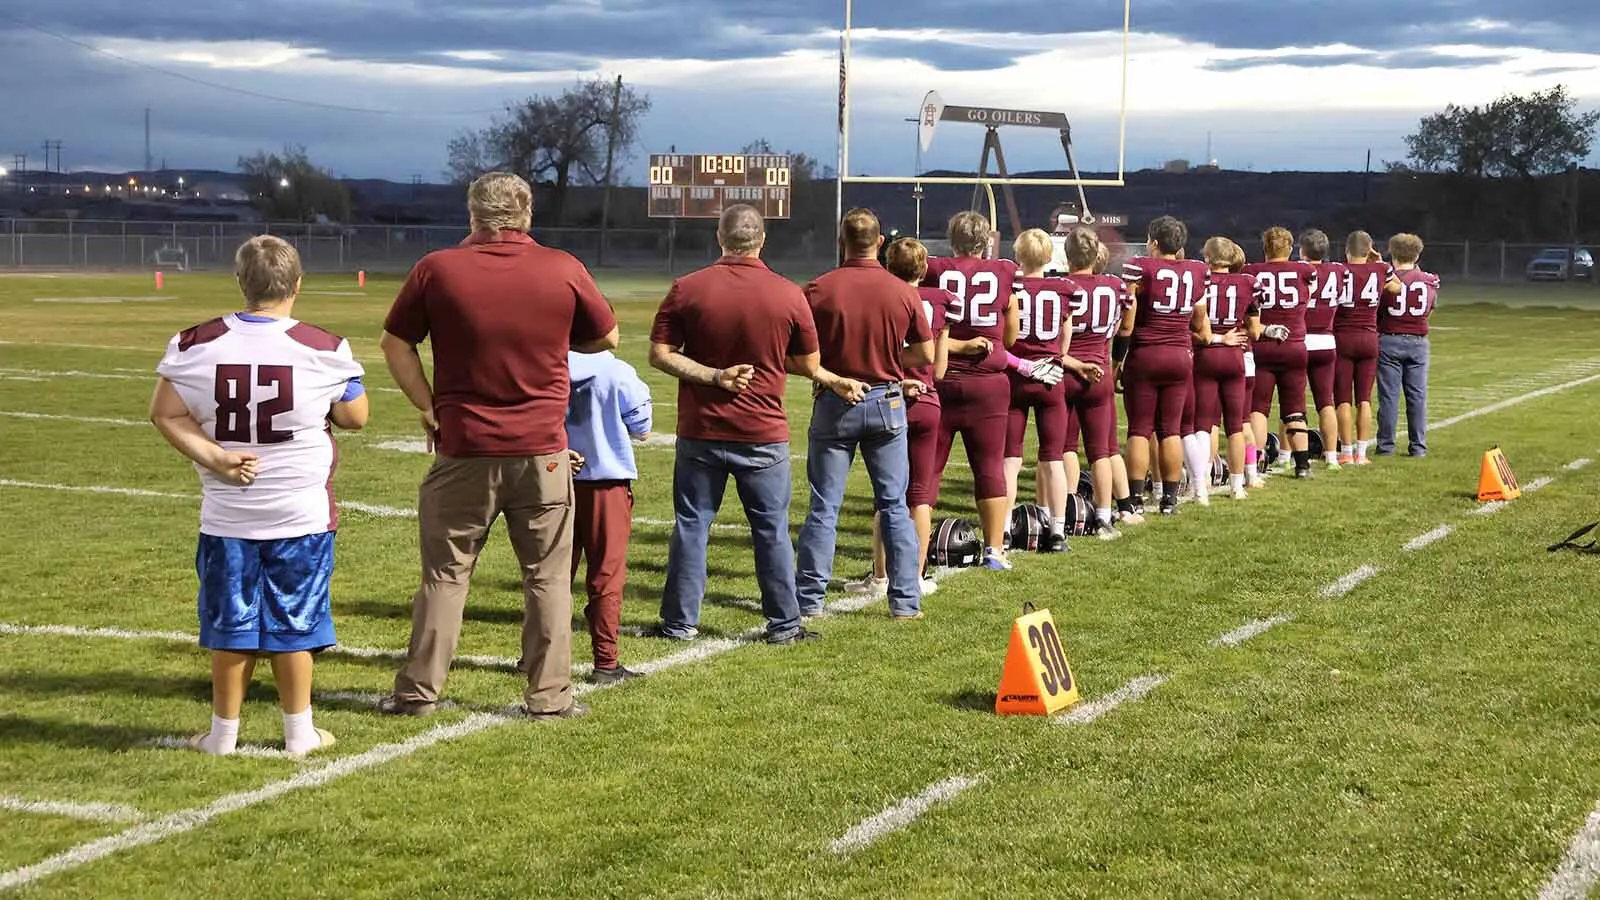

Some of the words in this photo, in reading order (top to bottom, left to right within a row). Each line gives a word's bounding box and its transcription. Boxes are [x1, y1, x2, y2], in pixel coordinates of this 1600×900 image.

[968, 109, 987, 121] GO
[991, 111, 1041, 124] OILERS
[701, 155, 745, 174] 10:00
[650, 166, 673, 185] 00
[766, 167, 789, 185] 00
[778, 199, 783, 217] 1
[1101, 216, 1121, 224] MHS
[1152, 269, 1193, 315] 31
[1388, 281, 1428, 317] 33
[1206, 284, 1238, 325] 11
[214, 363, 294, 444] 82
[1028, 620, 1072, 697] 30
